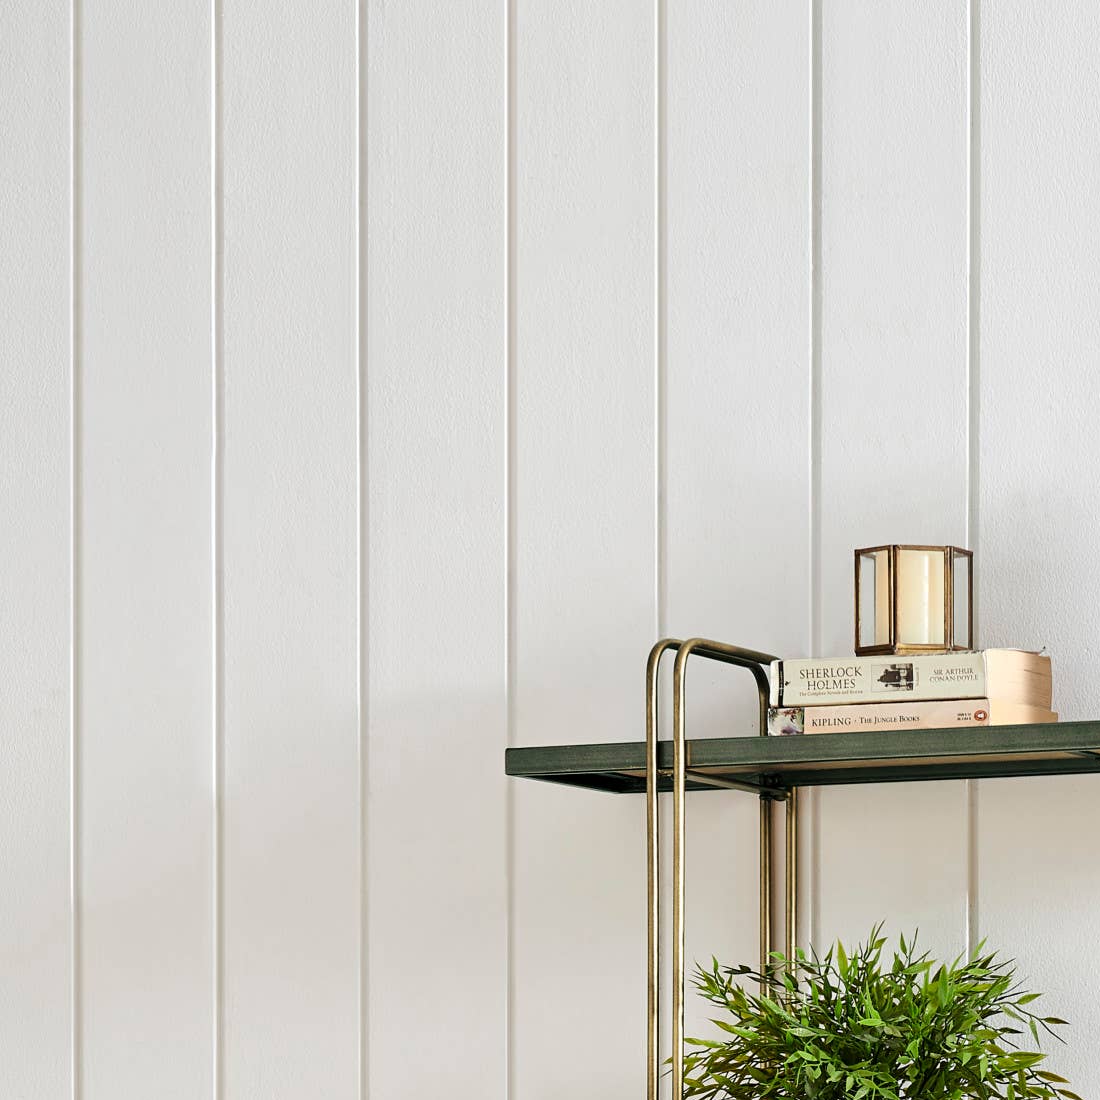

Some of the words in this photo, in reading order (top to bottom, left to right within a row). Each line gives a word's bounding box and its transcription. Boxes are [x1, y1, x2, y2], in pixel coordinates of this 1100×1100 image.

[800, 667, 862, 679] SHERLOCK
[945, 667, 974, 675] ARTHUR
[807, 679, 856, 691] HOLMES
[812, 717, 851, 727] KIPLING
